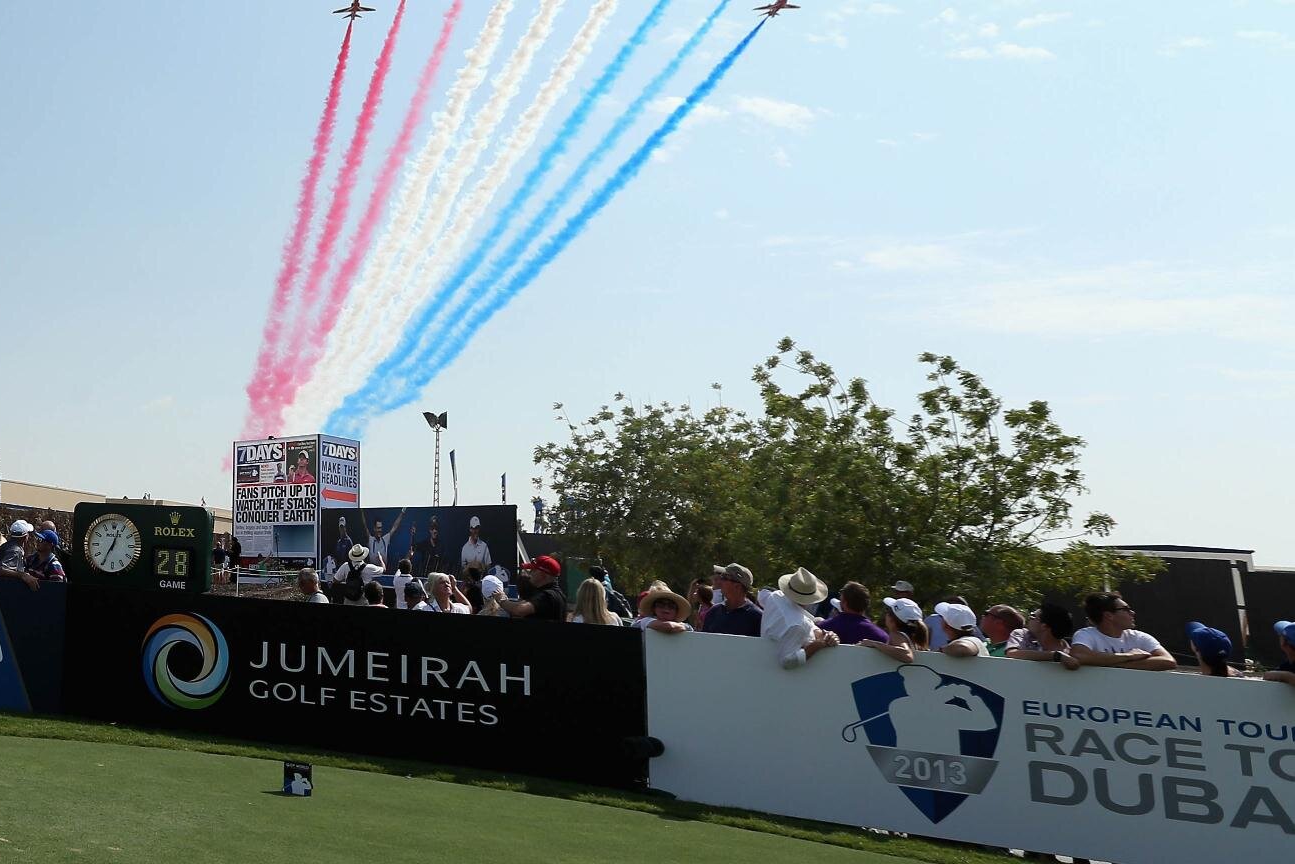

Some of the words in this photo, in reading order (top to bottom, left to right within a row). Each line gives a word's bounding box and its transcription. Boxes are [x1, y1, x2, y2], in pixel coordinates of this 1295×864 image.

[237, 443, 283, 464] 7DAYS
[322, 441, 356, 460] 7DAYS
[322, 460, 341, 475] MAKE
[343, 464, 358, 477] THE
[321, 473, 358, 489] HEADLINES
[236, 487, 259, 500] FANS
[261, 485, 286, 499] PITCH
[289, 485, 303, 498] UP
[304, 484, 317, 497] TO
[236, 498, 265, 512] WATCH
[267, 498, 285, 511] THE
[287, 497, 317, 510] STARS
[236, 510, 279, 524] CONQUER
[283, 509, 316, 522] EARTH
[153, 526, 196, 538] ROLEX
[157, 550, 187, 576] 28
[159, 579, 186, 590] GAME
[249, 641, 531, 696] JUMEIRAH
[249, 679, 337, 706] GOLF
[350, 690, 499, 725] ESTATES
[1022, 699, 1202, 733] EUROPEAN
[1216, 718, 1295, 742] TOU
[1024, 722, 1207, 772] RACE
[892, 755, 967, 785] 2013
